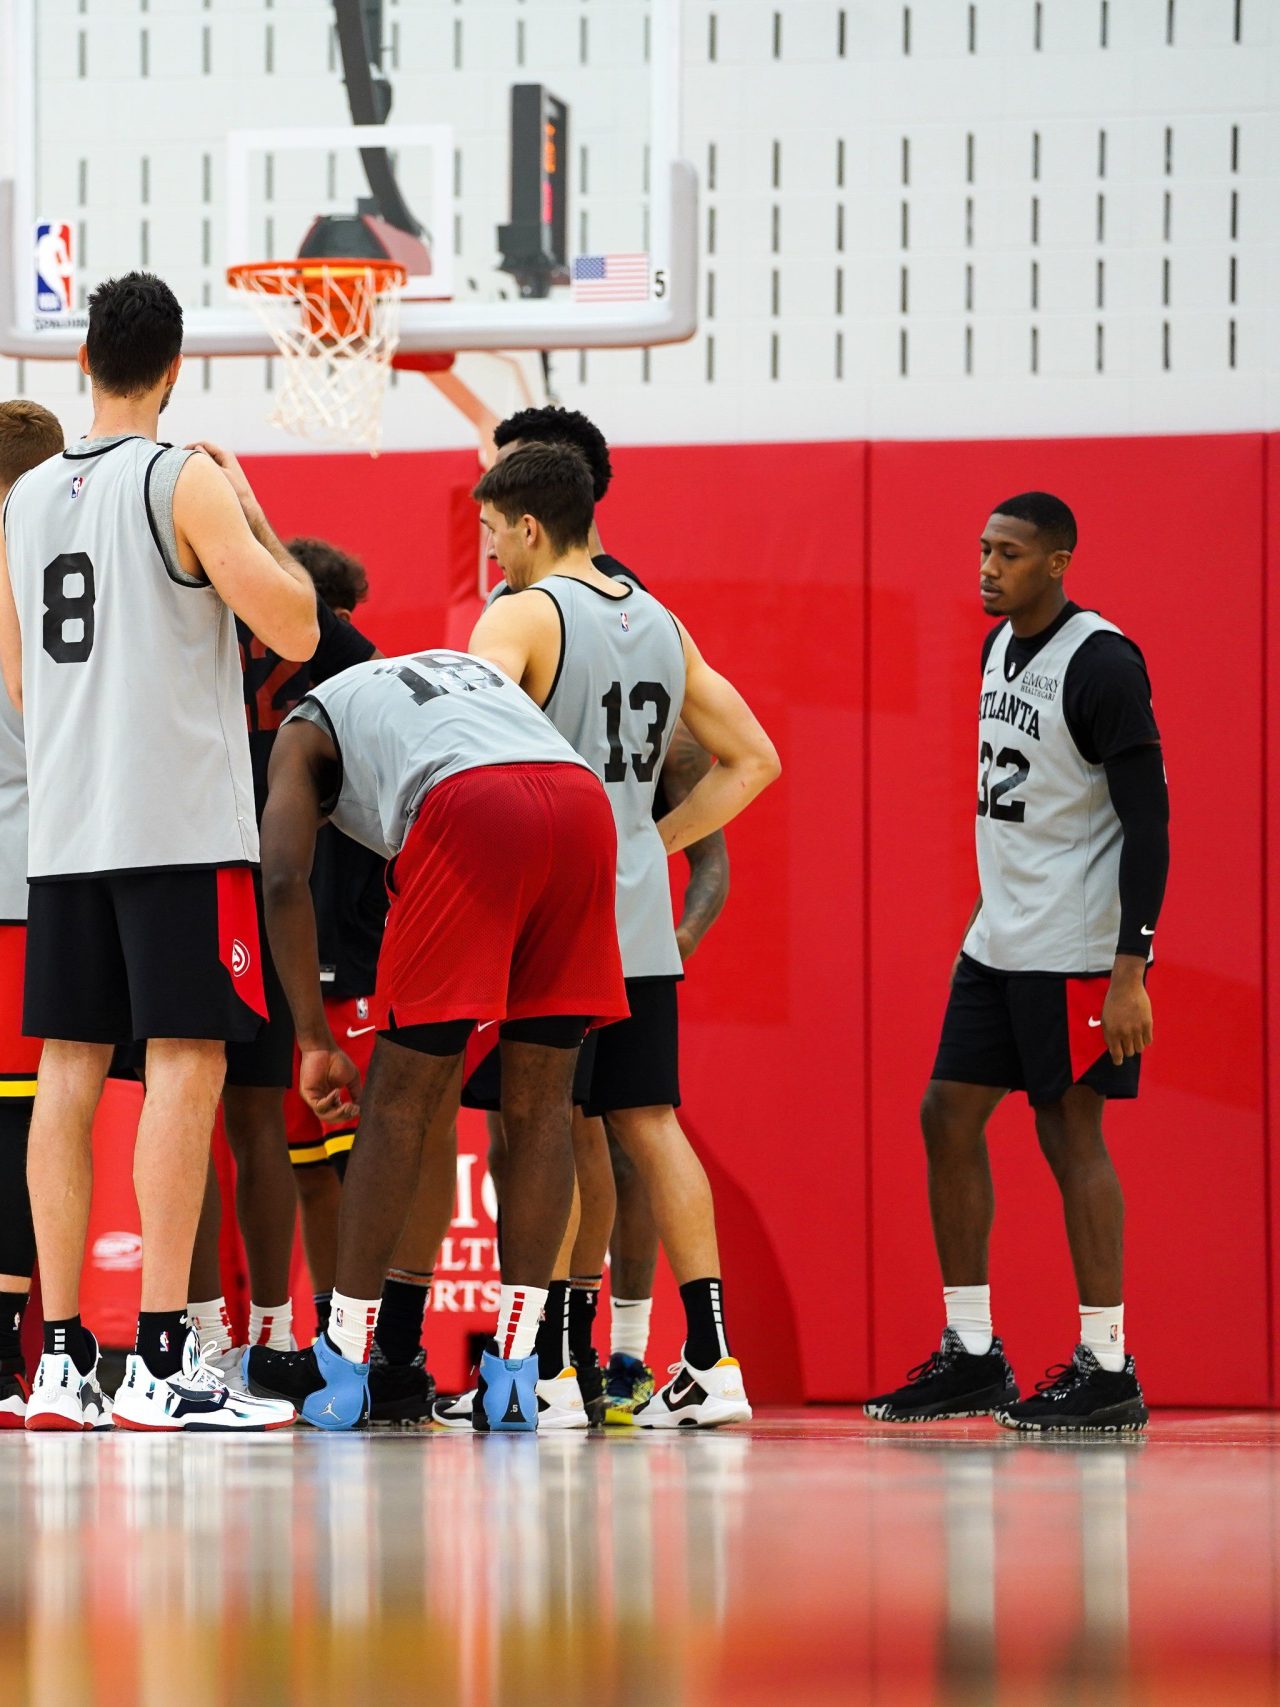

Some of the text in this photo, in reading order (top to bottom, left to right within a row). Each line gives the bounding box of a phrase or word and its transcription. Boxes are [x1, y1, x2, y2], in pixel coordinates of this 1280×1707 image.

[655, 270, 666, 298] 5
[43, 552, 95, 663] 8
[1022, 671, 1060, 694] EMORY
[602, 682, 671, 782] 13
[977, 741, 1031, 823] 32
